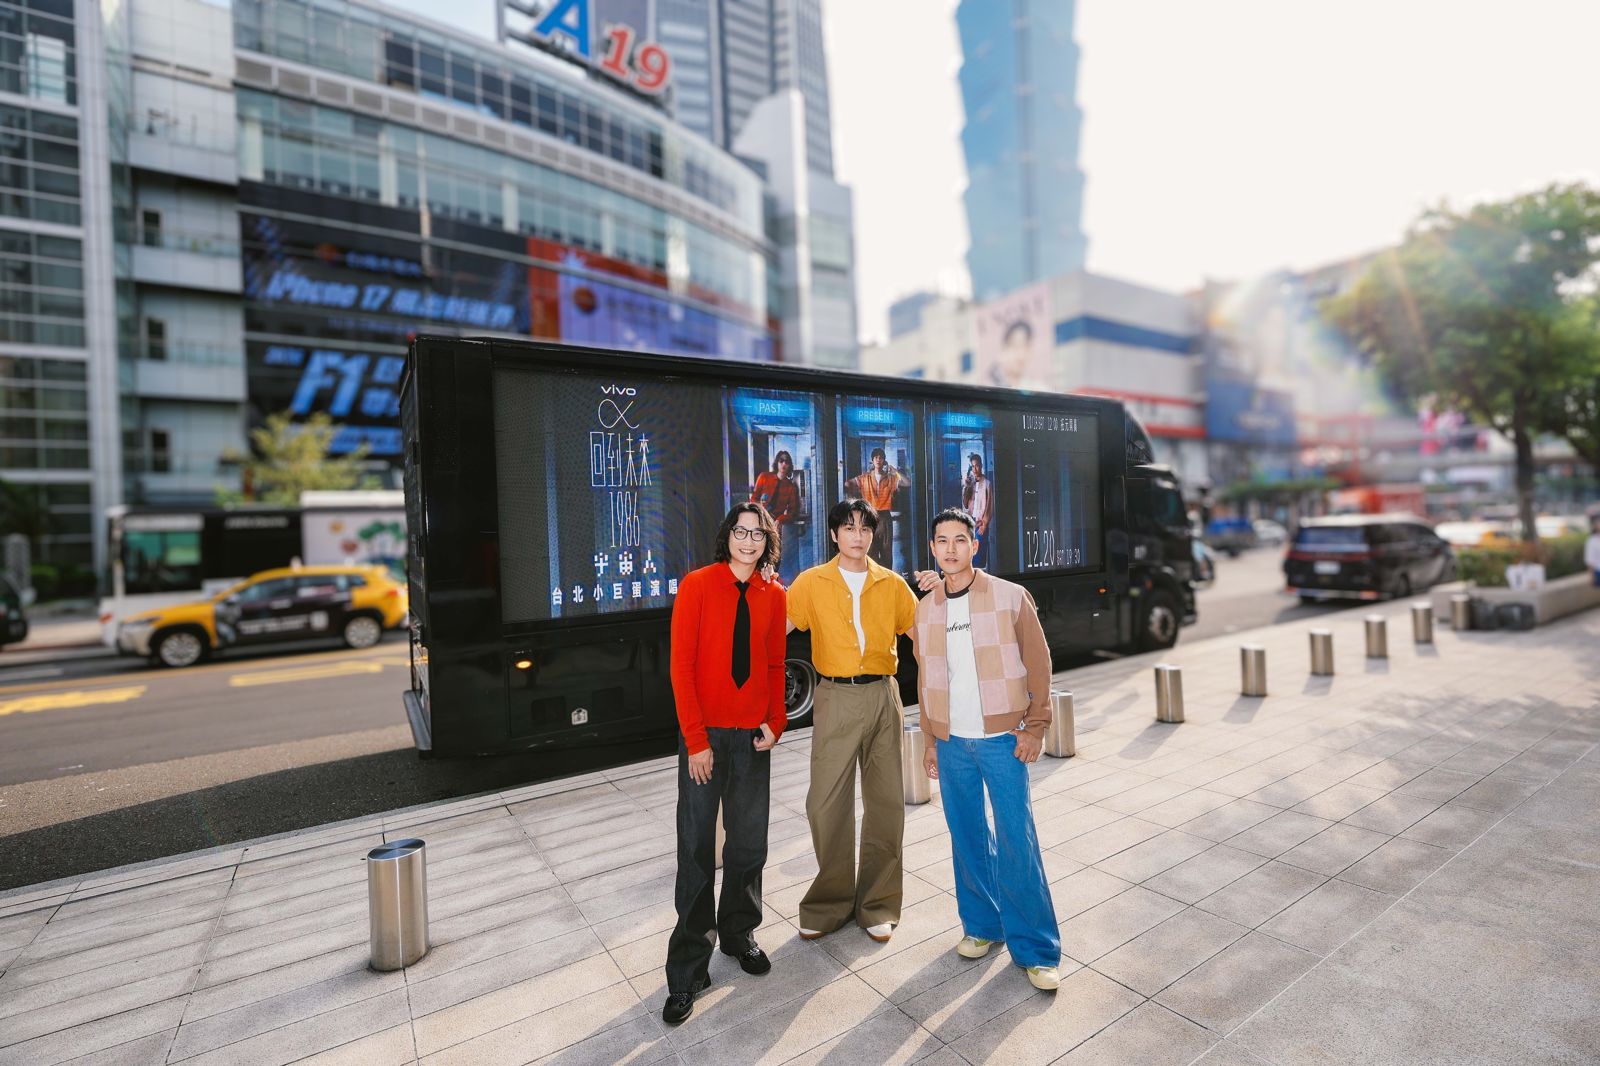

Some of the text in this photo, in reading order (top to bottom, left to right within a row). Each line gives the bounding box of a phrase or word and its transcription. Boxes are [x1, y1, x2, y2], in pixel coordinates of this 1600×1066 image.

[602, 27, 671, 91] 19
[601, 384, 636, 396] vivo
[759, 402, 782, 413] PAST
[858, 410, 894, 421] PRESENT
[950, 415, 977, 426] FUTURE
[609, 491, 641, 548] 1986
[1027, 530, 1055, 568] 12.20
[594, 550, 657, 577] 宇宙人
